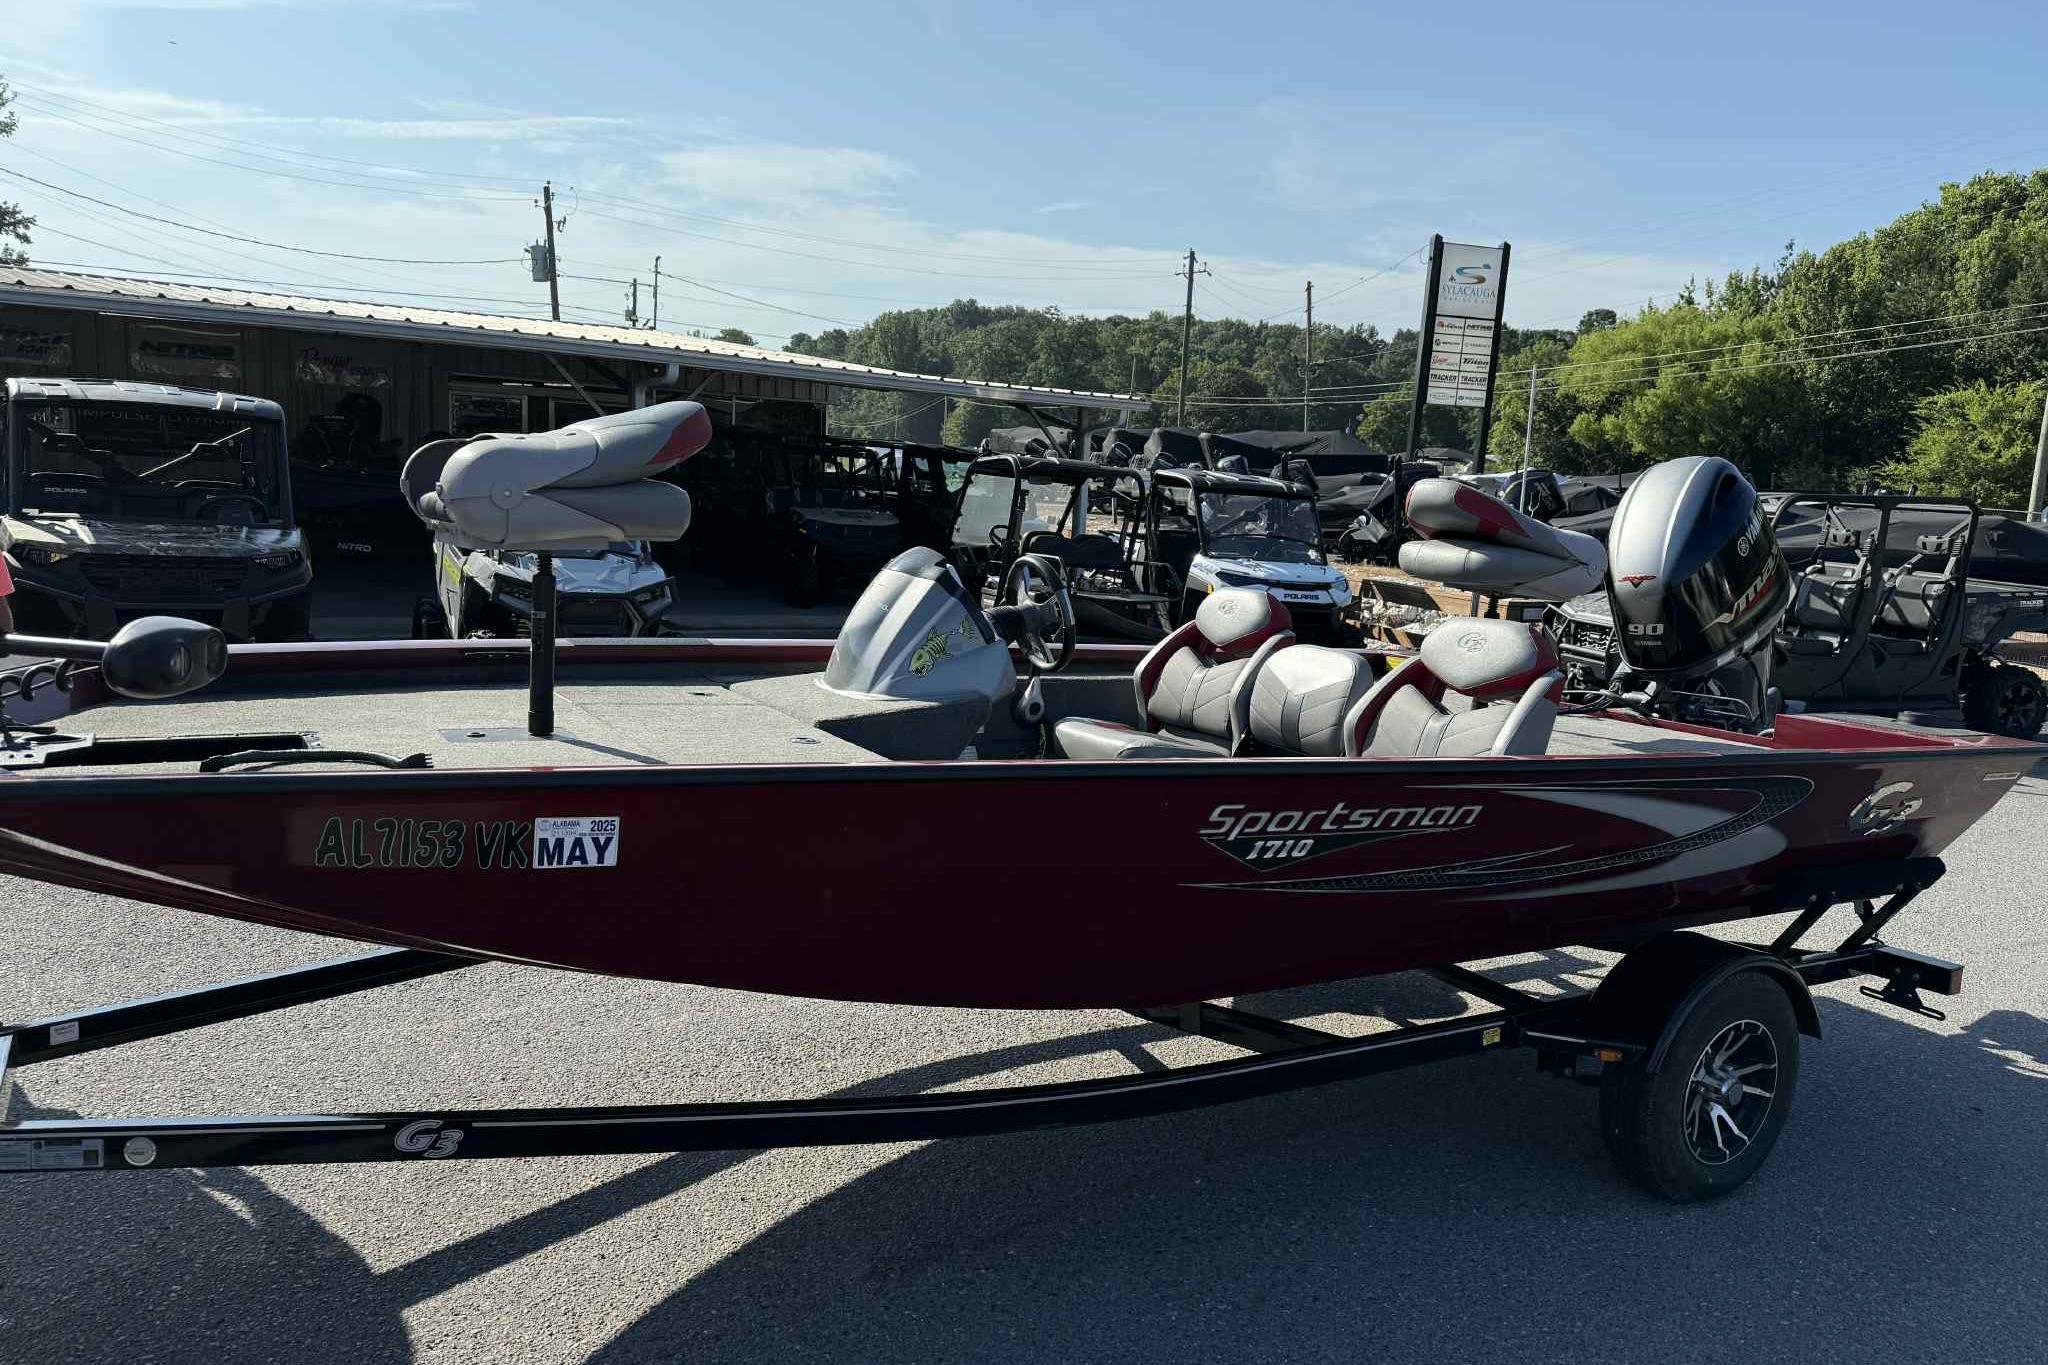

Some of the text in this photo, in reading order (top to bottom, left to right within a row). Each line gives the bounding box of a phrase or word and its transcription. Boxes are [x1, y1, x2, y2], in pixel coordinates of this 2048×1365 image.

[1430, 373, 1457, 381] TRACKER
[336, 541, 373, 553] NITRO
[1283, 593, 1320, 601] POLARIS
[1627, 623, 1664, 636] 90
[552, 819, 580, 829] ALABAMA
[590, 819, 617, 833] 2025
[1200, 801, 1484, 841] Sportsman
[474, 820, 531, 869] VK
[537, 836, 614, 867] MAY
[1245, 839, 1315, 860] 1710
[394, 1119, 464, 1158] G3
